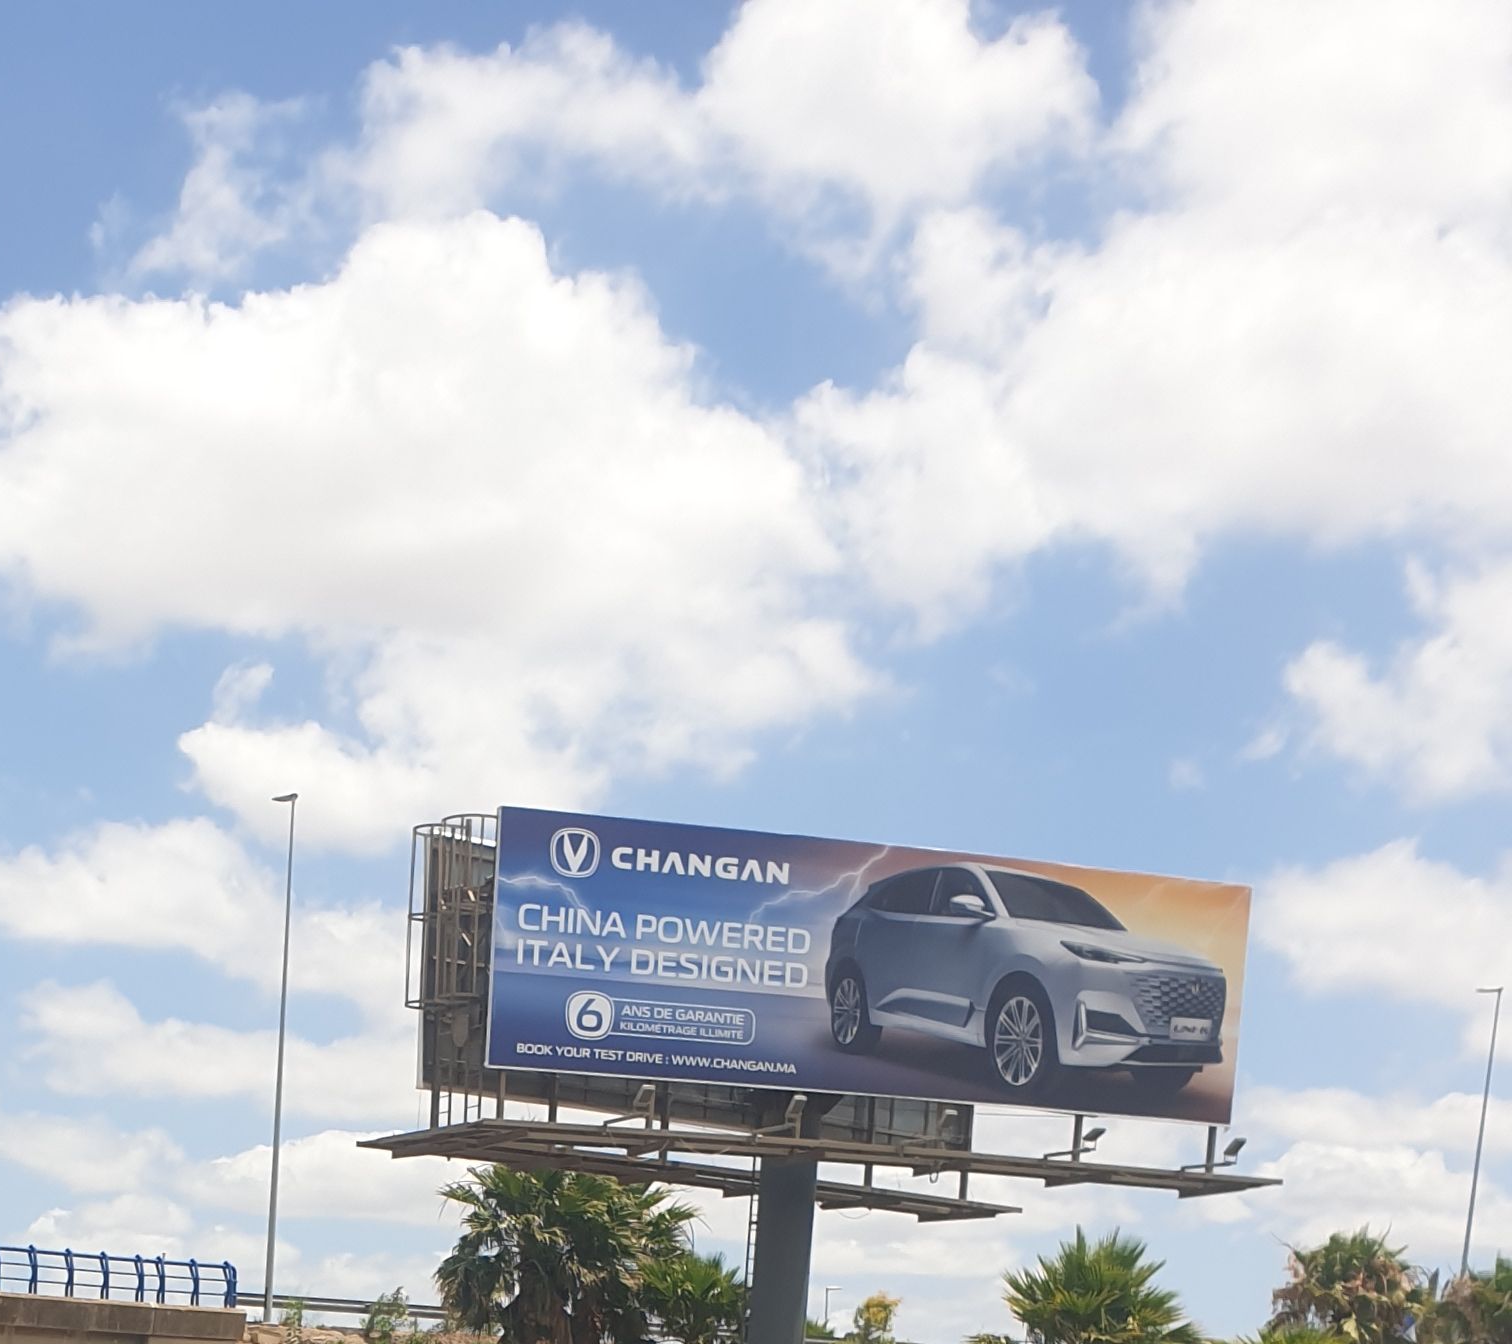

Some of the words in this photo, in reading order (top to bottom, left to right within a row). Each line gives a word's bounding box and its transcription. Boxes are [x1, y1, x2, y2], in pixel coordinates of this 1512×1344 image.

[611, 847, 789, 884] CHANGAN
[518, 904, 626, 938] CHINA
[637, 914, 811, 954] POWERED
[517, 939, 620, 972] ITALY
[631, 949, 808, 988] DESIGNED
[577, 999, 603, 1028] 6
[621, 1005, 651, 1017] ANS
[654, 1007, 673, 1020] DE
[675, 1009, 745, 1025] GARANTIE
[516, 1043, 553, 1055] BOOK
[555, 1046, 591, 1058] YOUR
[593, 1048, 624, 1061] TEST
[671, 1054, 797, 1074] WWW.CHANGAN.MA
